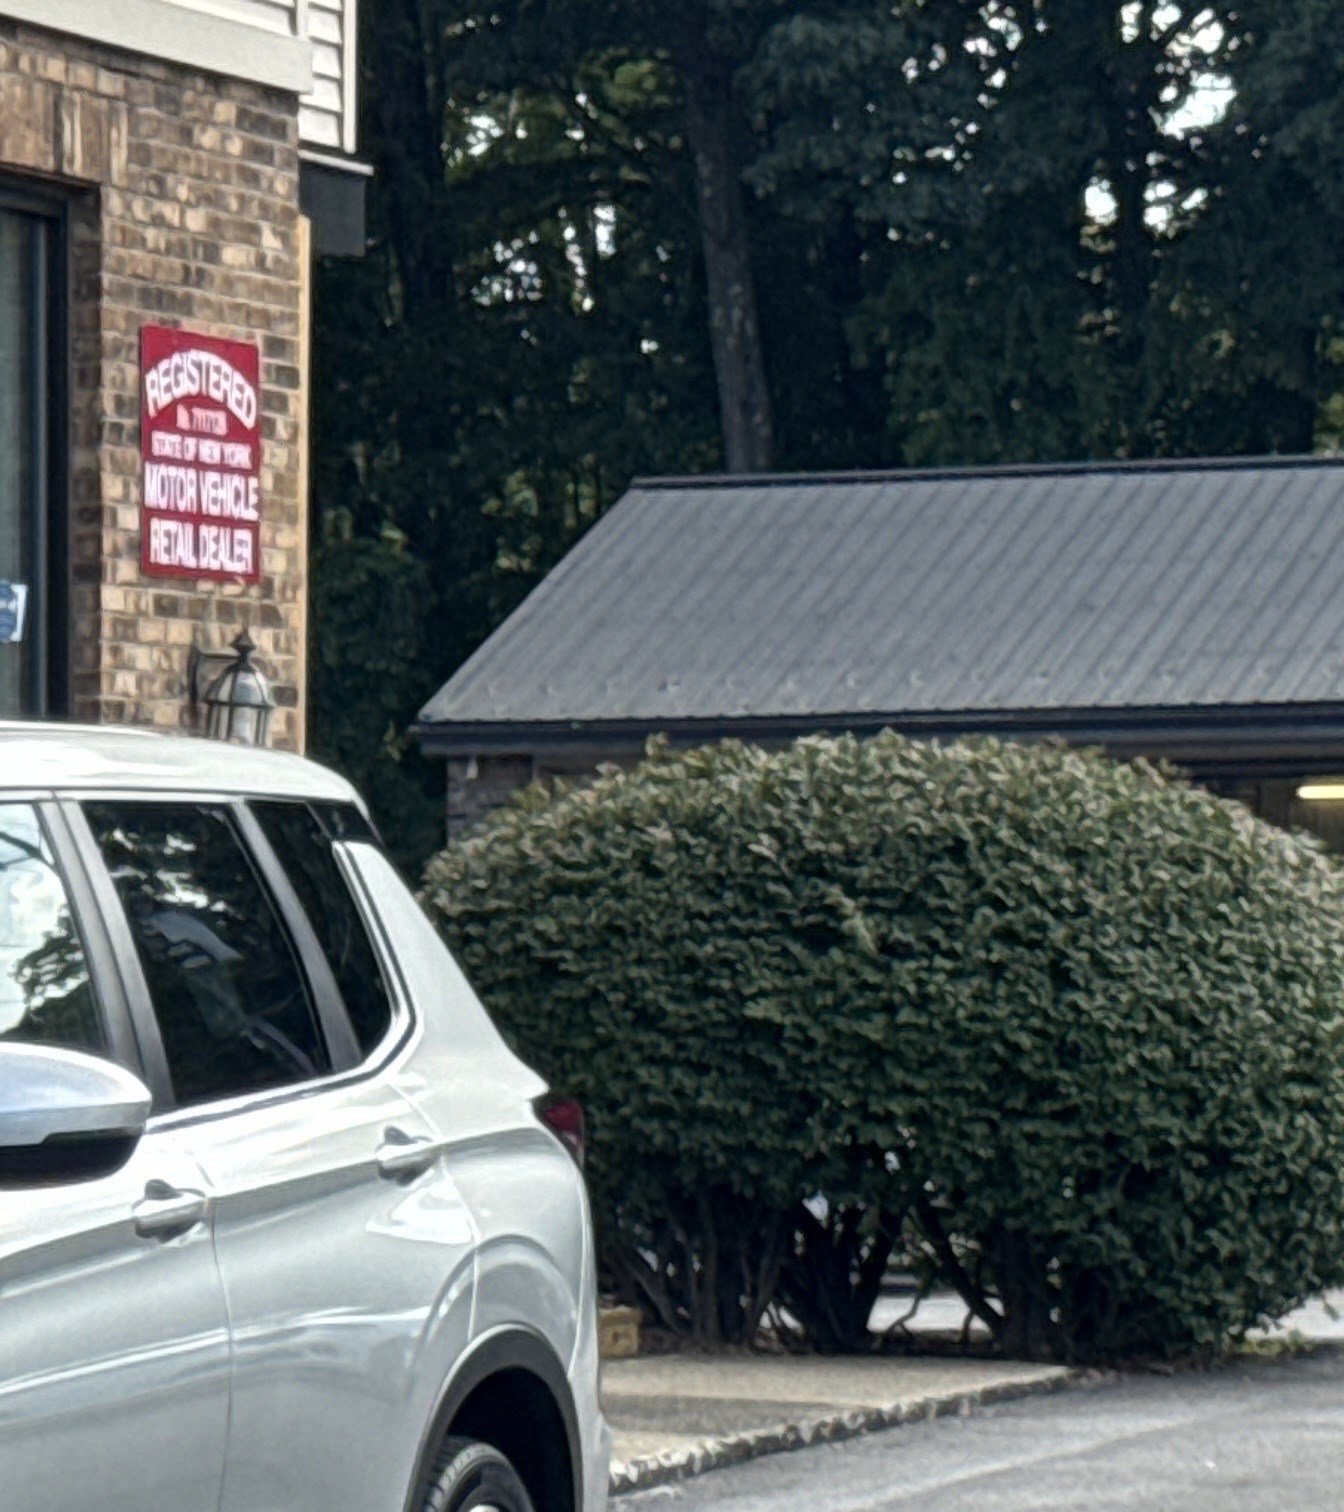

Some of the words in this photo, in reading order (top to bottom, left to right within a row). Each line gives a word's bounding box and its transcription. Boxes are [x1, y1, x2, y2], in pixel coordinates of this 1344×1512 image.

[145, 350, 257, 430] REGISTERED
[144, 462, 197, 515] MOTOR
[198, 469, 260, 521] VEHICLE
[149, 518, 197, 569] RETAIL
[198, 522, 253, 575] DEALER
